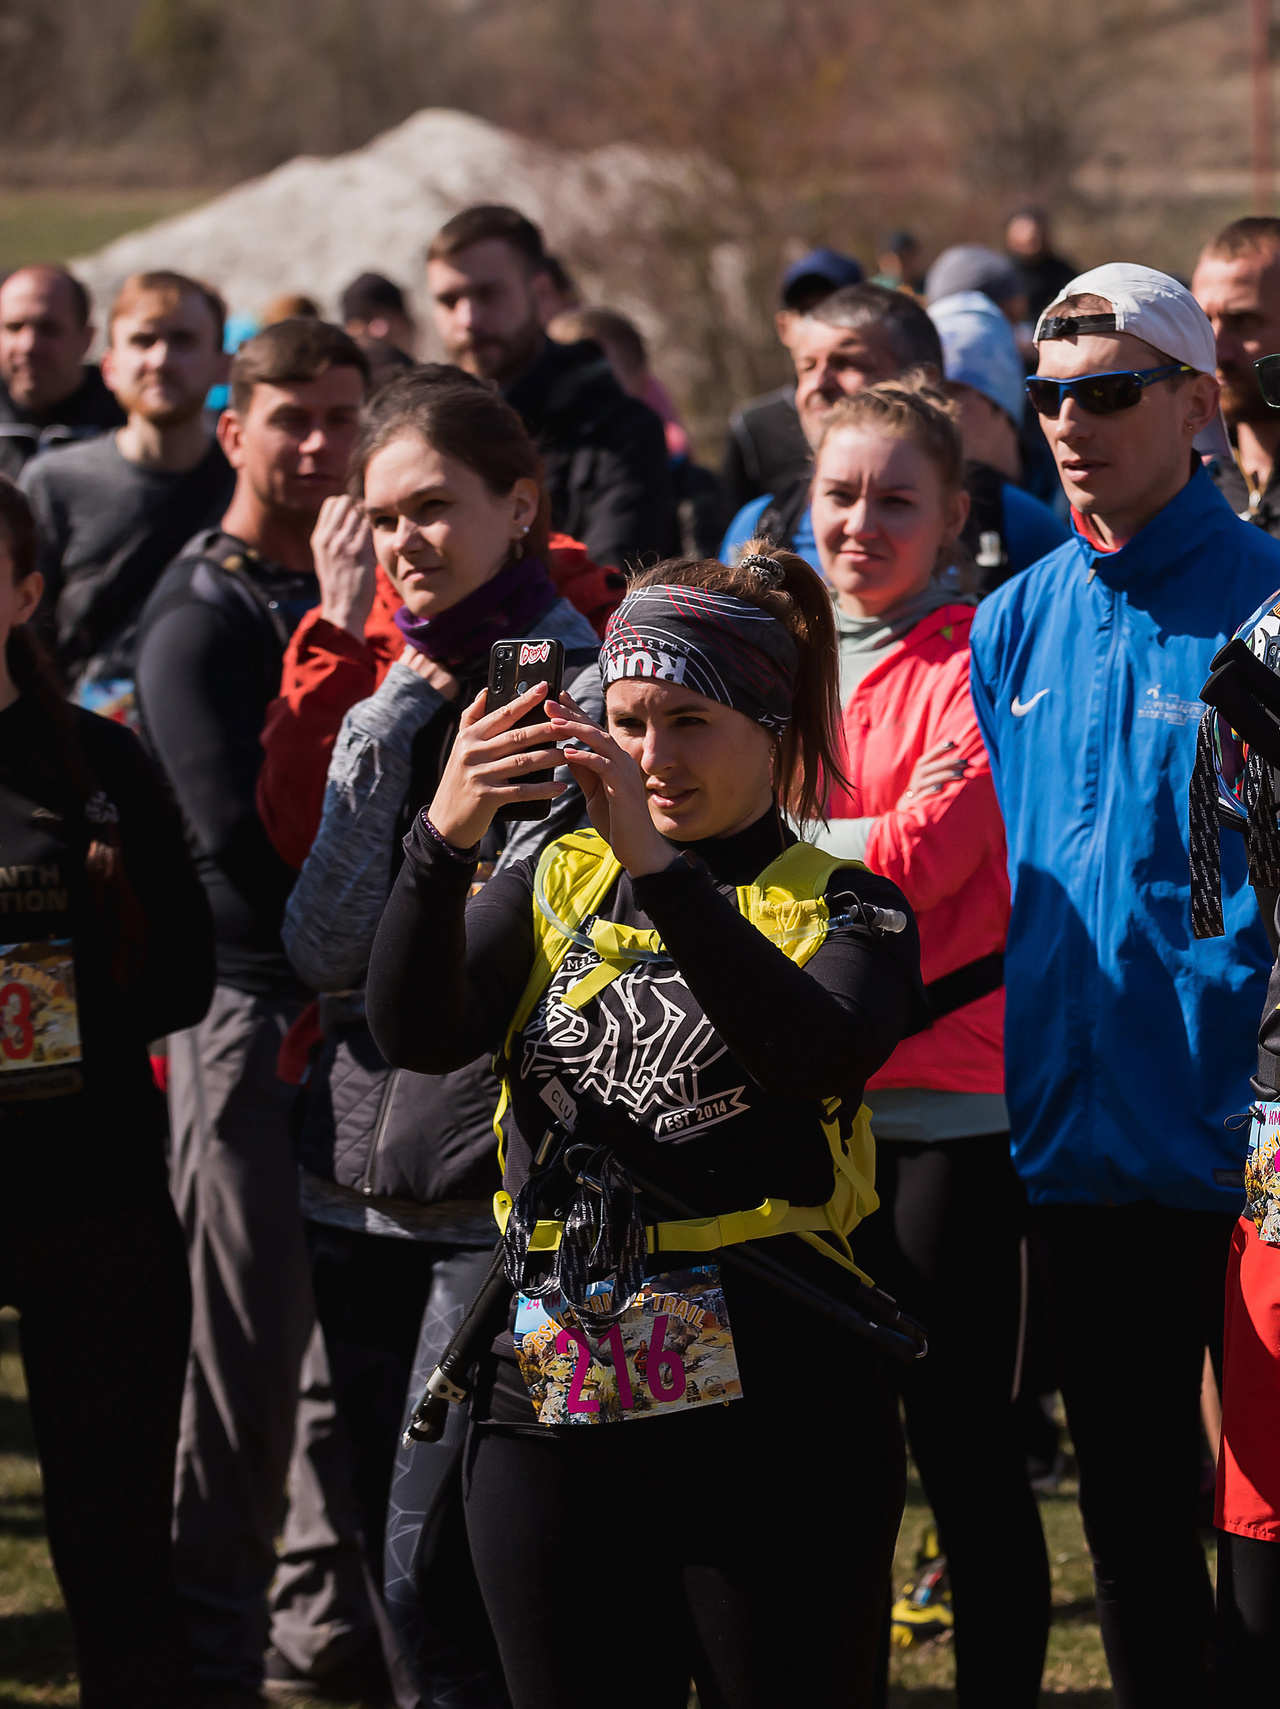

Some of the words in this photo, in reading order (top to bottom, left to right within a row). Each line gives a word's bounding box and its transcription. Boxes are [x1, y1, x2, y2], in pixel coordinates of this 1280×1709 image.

[607, 651, 687, 685] RUN
[566, 953, 604, 970] Mik
[0, 983, 34, 1060] 3
[551, 1089, 577, 1126] CLU
[664, 1111, 690, 1133] EST
[696, 1100, 727, 1122] 2014
[652, 1293, 705, 1330] TRAIL
[556, 1314, 687, 1414] 216
